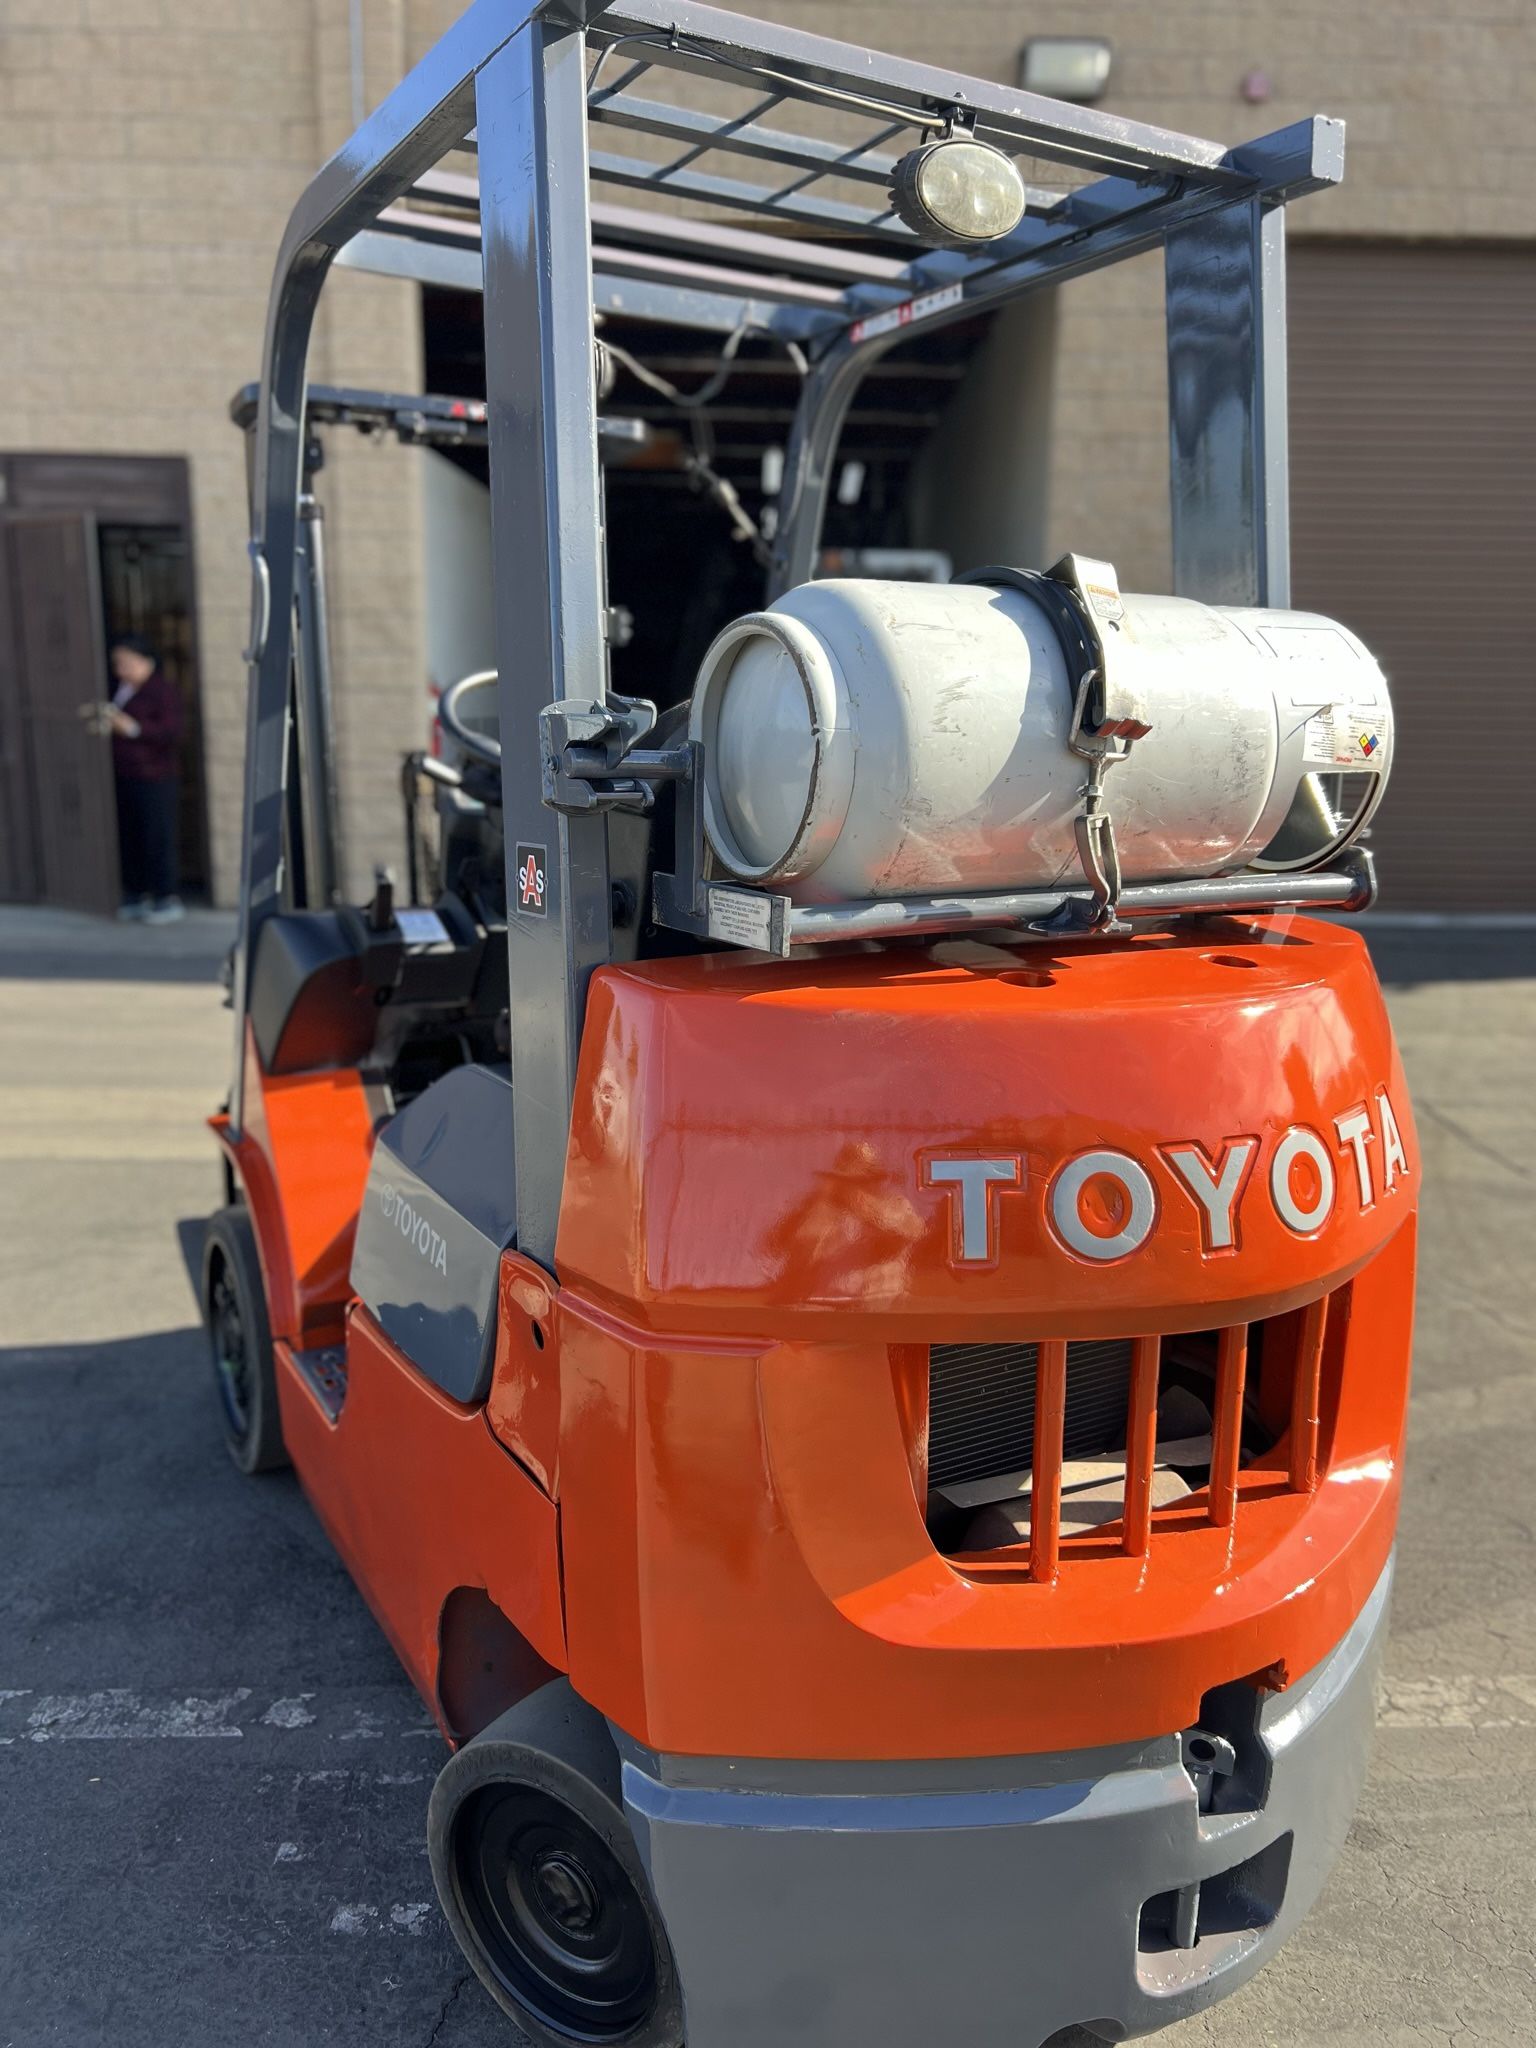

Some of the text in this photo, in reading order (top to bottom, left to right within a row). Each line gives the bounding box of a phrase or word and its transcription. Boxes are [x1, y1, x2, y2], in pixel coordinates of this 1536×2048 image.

[519, 854, 545, 907] SAS
[922, 1088, 1410, 1264] TOYOTA
[394, 1194, 447, 1277] TOYOTA
